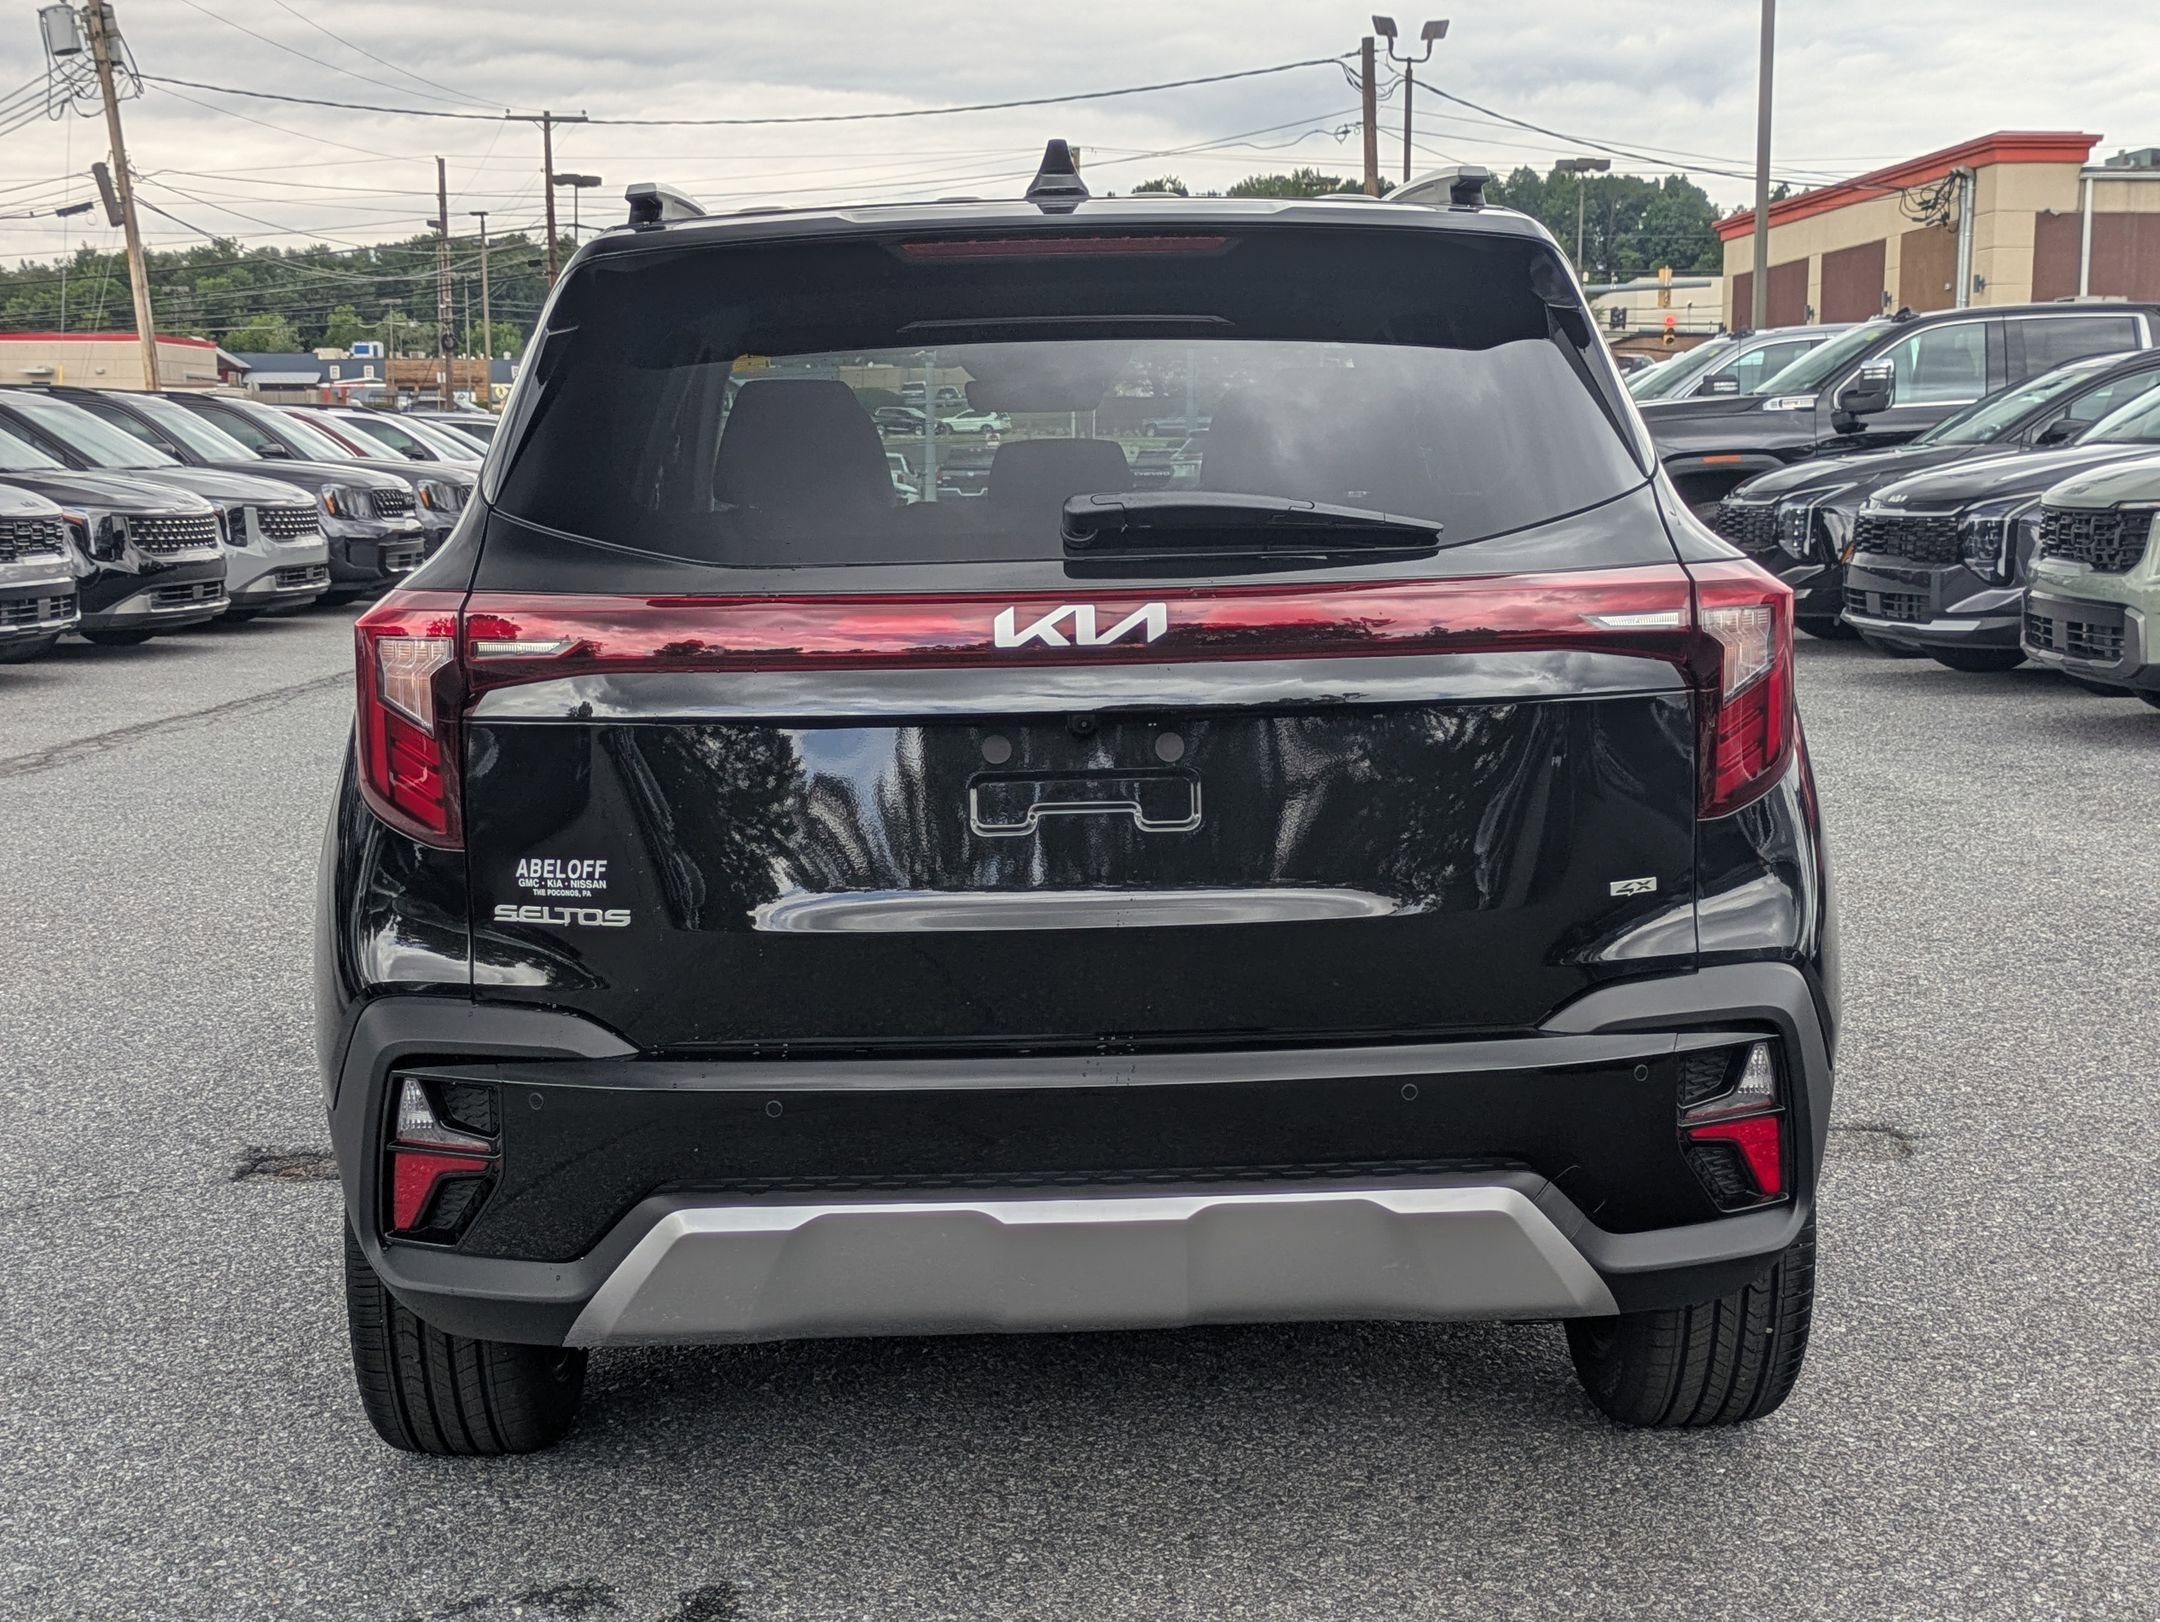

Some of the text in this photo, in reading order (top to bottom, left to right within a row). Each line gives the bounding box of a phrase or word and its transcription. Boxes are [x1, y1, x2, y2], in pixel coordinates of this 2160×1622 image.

[994, 602, 1167, 648] KIA
[515, 858, 608, 879] ABELOFF
[518, 878, 607, 889] GMC KIA NISSAN
[494, 904, 631, 927] SELTOS
